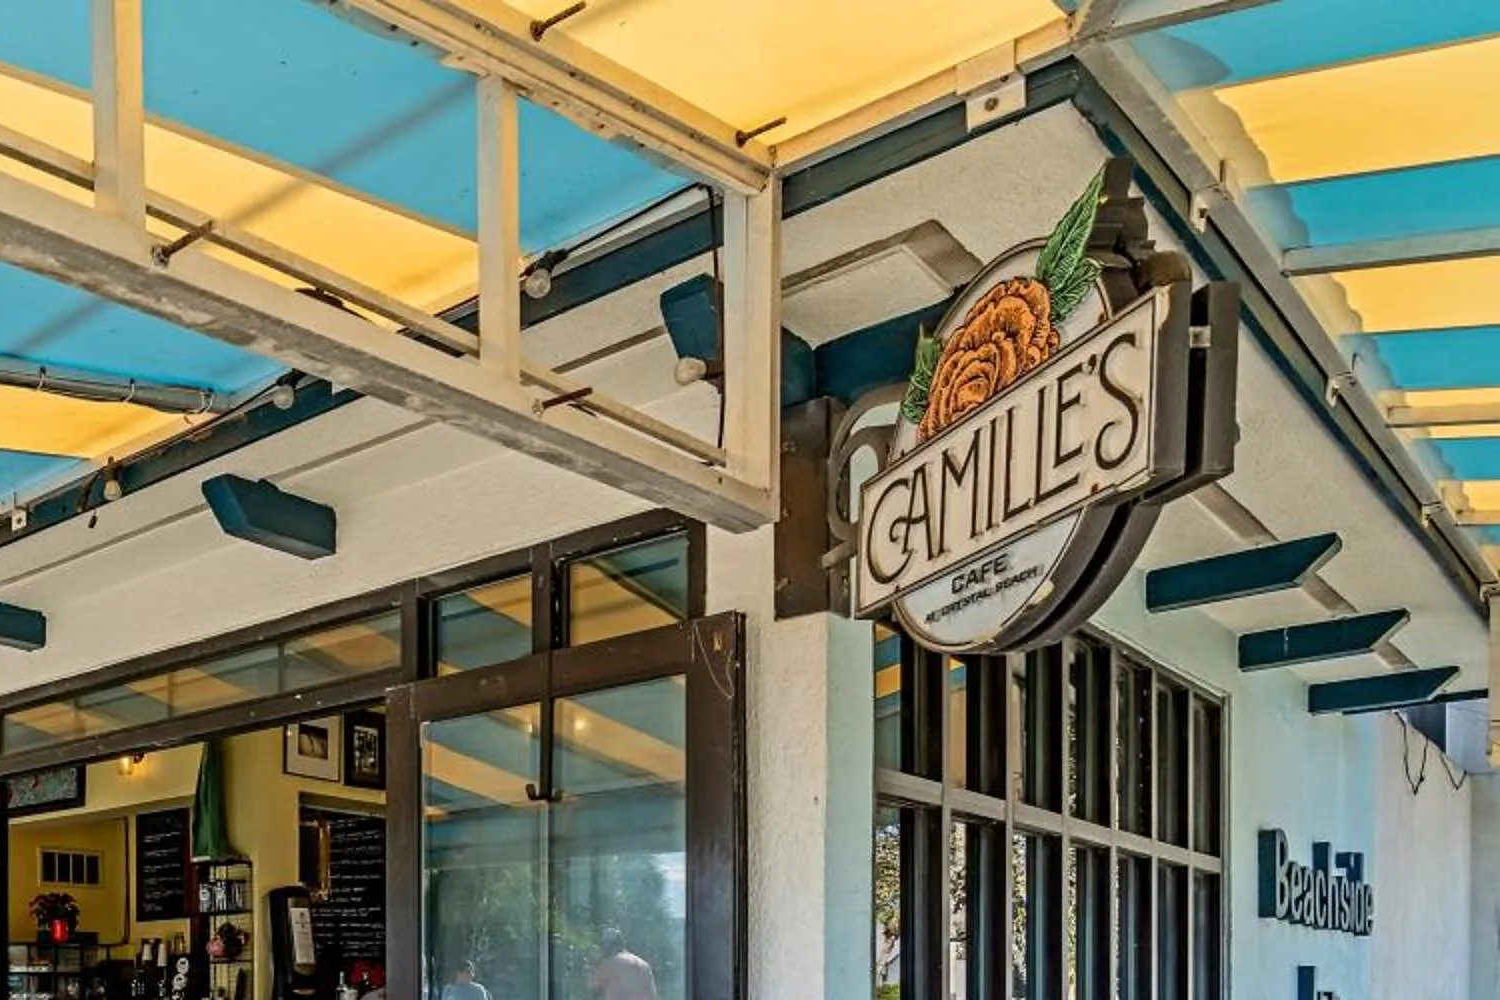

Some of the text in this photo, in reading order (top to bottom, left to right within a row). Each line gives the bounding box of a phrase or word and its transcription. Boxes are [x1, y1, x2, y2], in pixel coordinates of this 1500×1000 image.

[867, 332, 1139, 584] CAMILLE'S
[951, 553, 1009, 594] CAFE
[1257, 827, 1374, 936] Beachside
